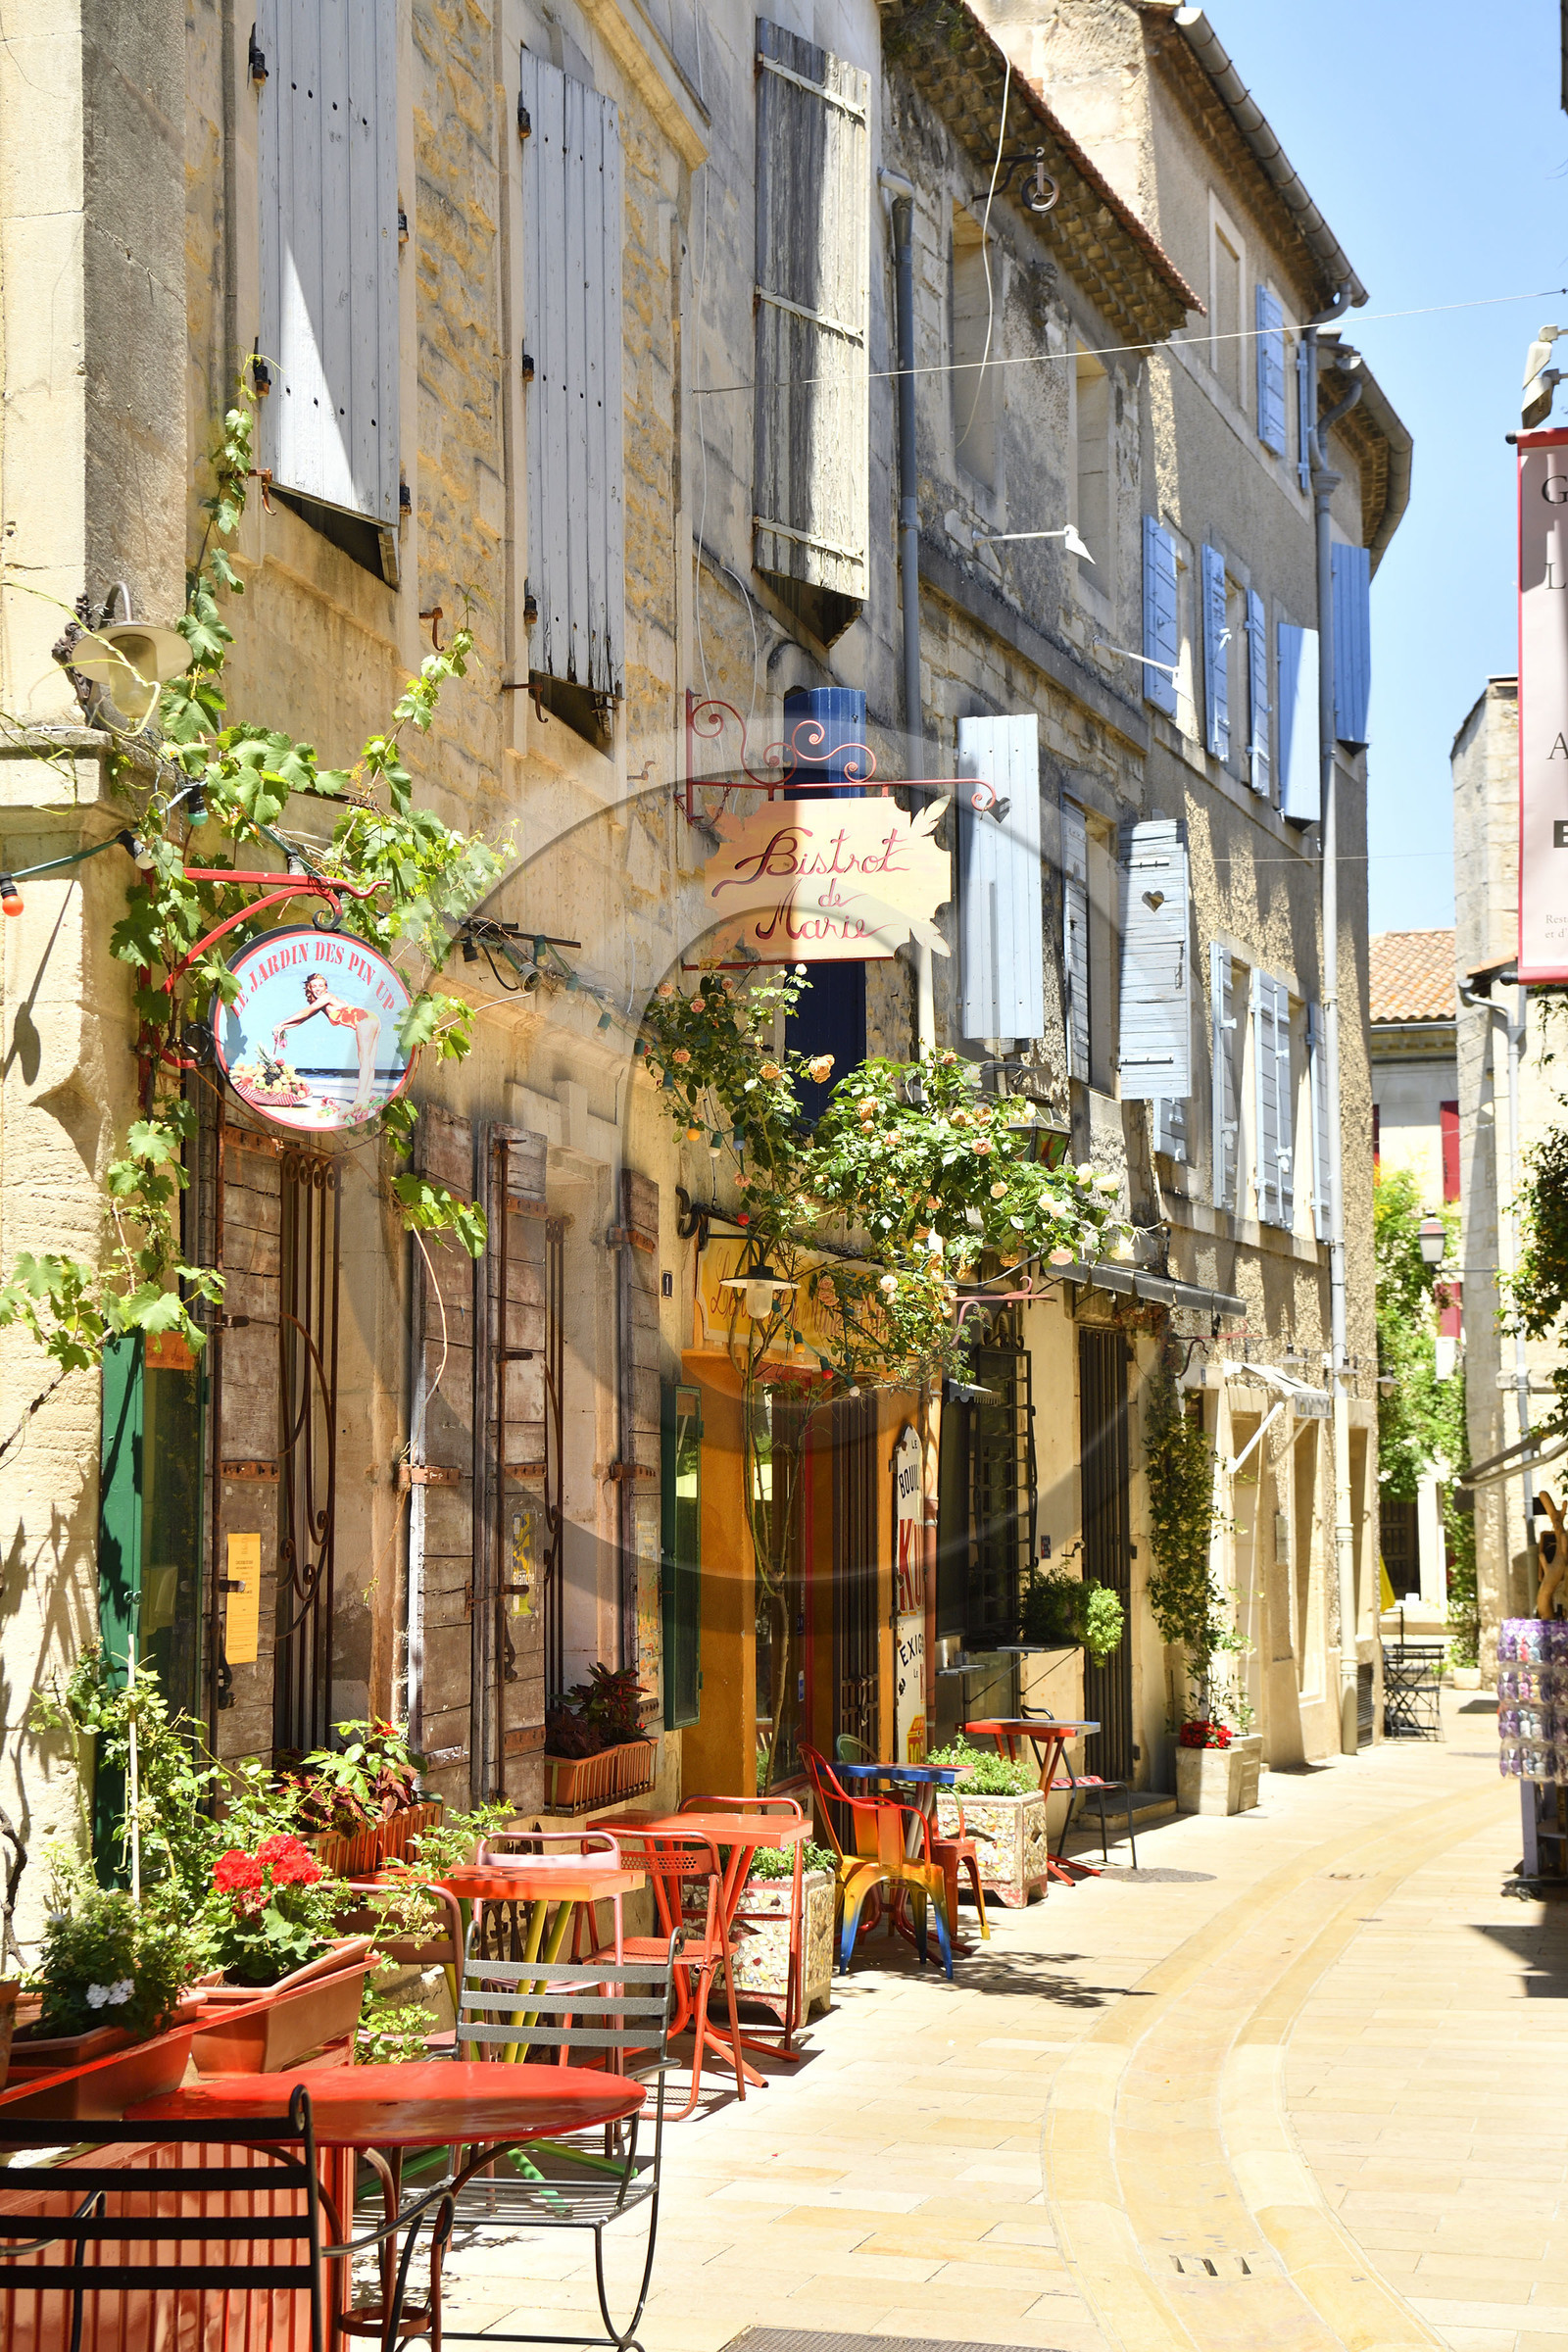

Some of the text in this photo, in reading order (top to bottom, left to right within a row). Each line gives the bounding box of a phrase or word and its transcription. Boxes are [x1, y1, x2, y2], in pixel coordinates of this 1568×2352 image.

[711, 826, 914, 897] Bistrot
[818, 877, 868, 907] de
[755, 878, 900, 941] Marie
[249, 943, 310, 993] JARDIN
[315, 941, 346, 965] DES
[348, 951, 376, 986] PIN
[376, 980, 396, 1010] UP
[911, 1440, 917, 1449] LE
[513, 1570, 535, 1586] Blanche
[899, 1518, 924, 1613] KU
